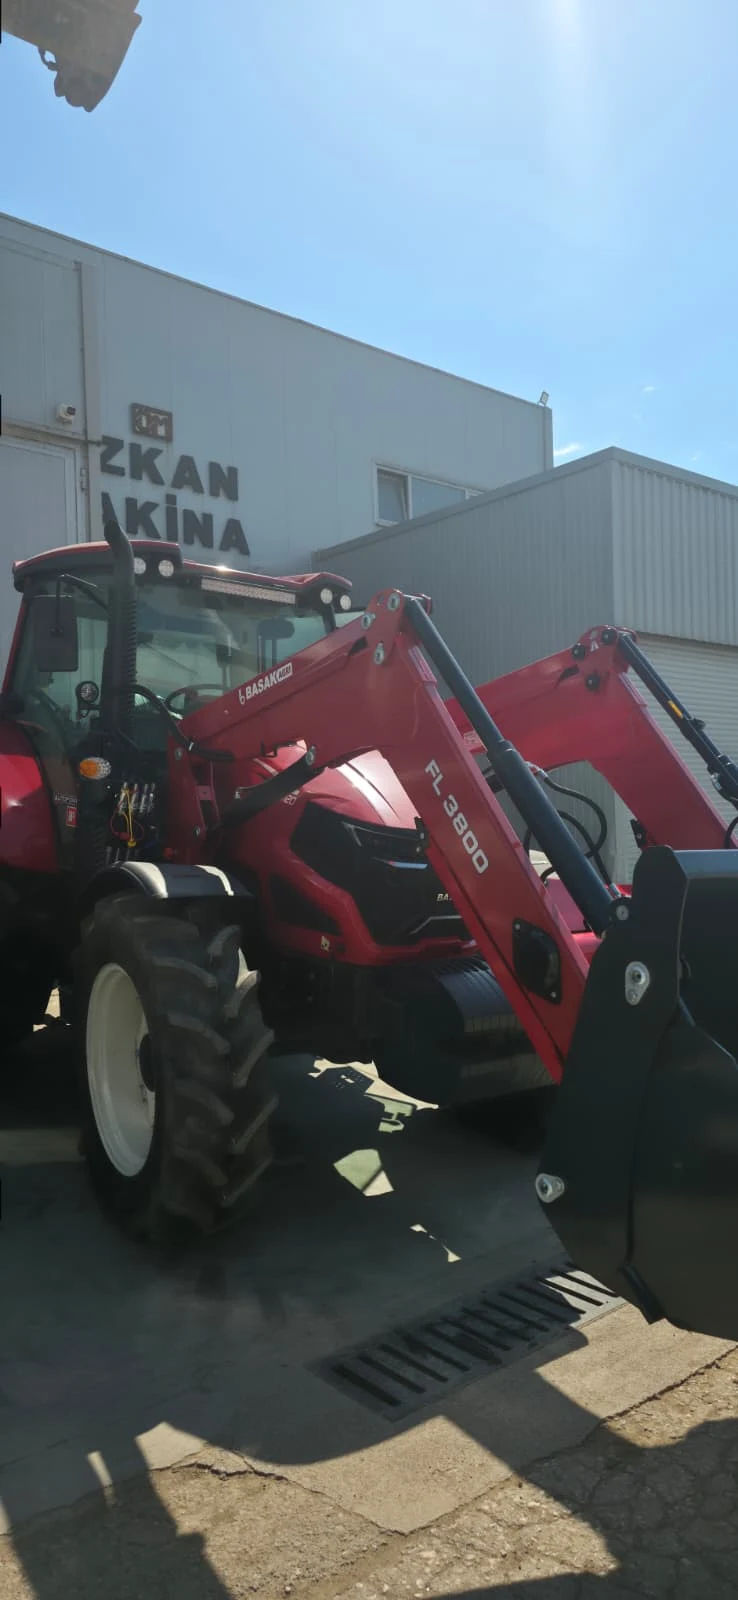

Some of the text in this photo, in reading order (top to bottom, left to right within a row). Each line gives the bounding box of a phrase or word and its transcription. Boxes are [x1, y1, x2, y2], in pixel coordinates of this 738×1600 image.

[245, 669, 278, 700] BASAK
[424, 759, 489, 874] FL 3800
